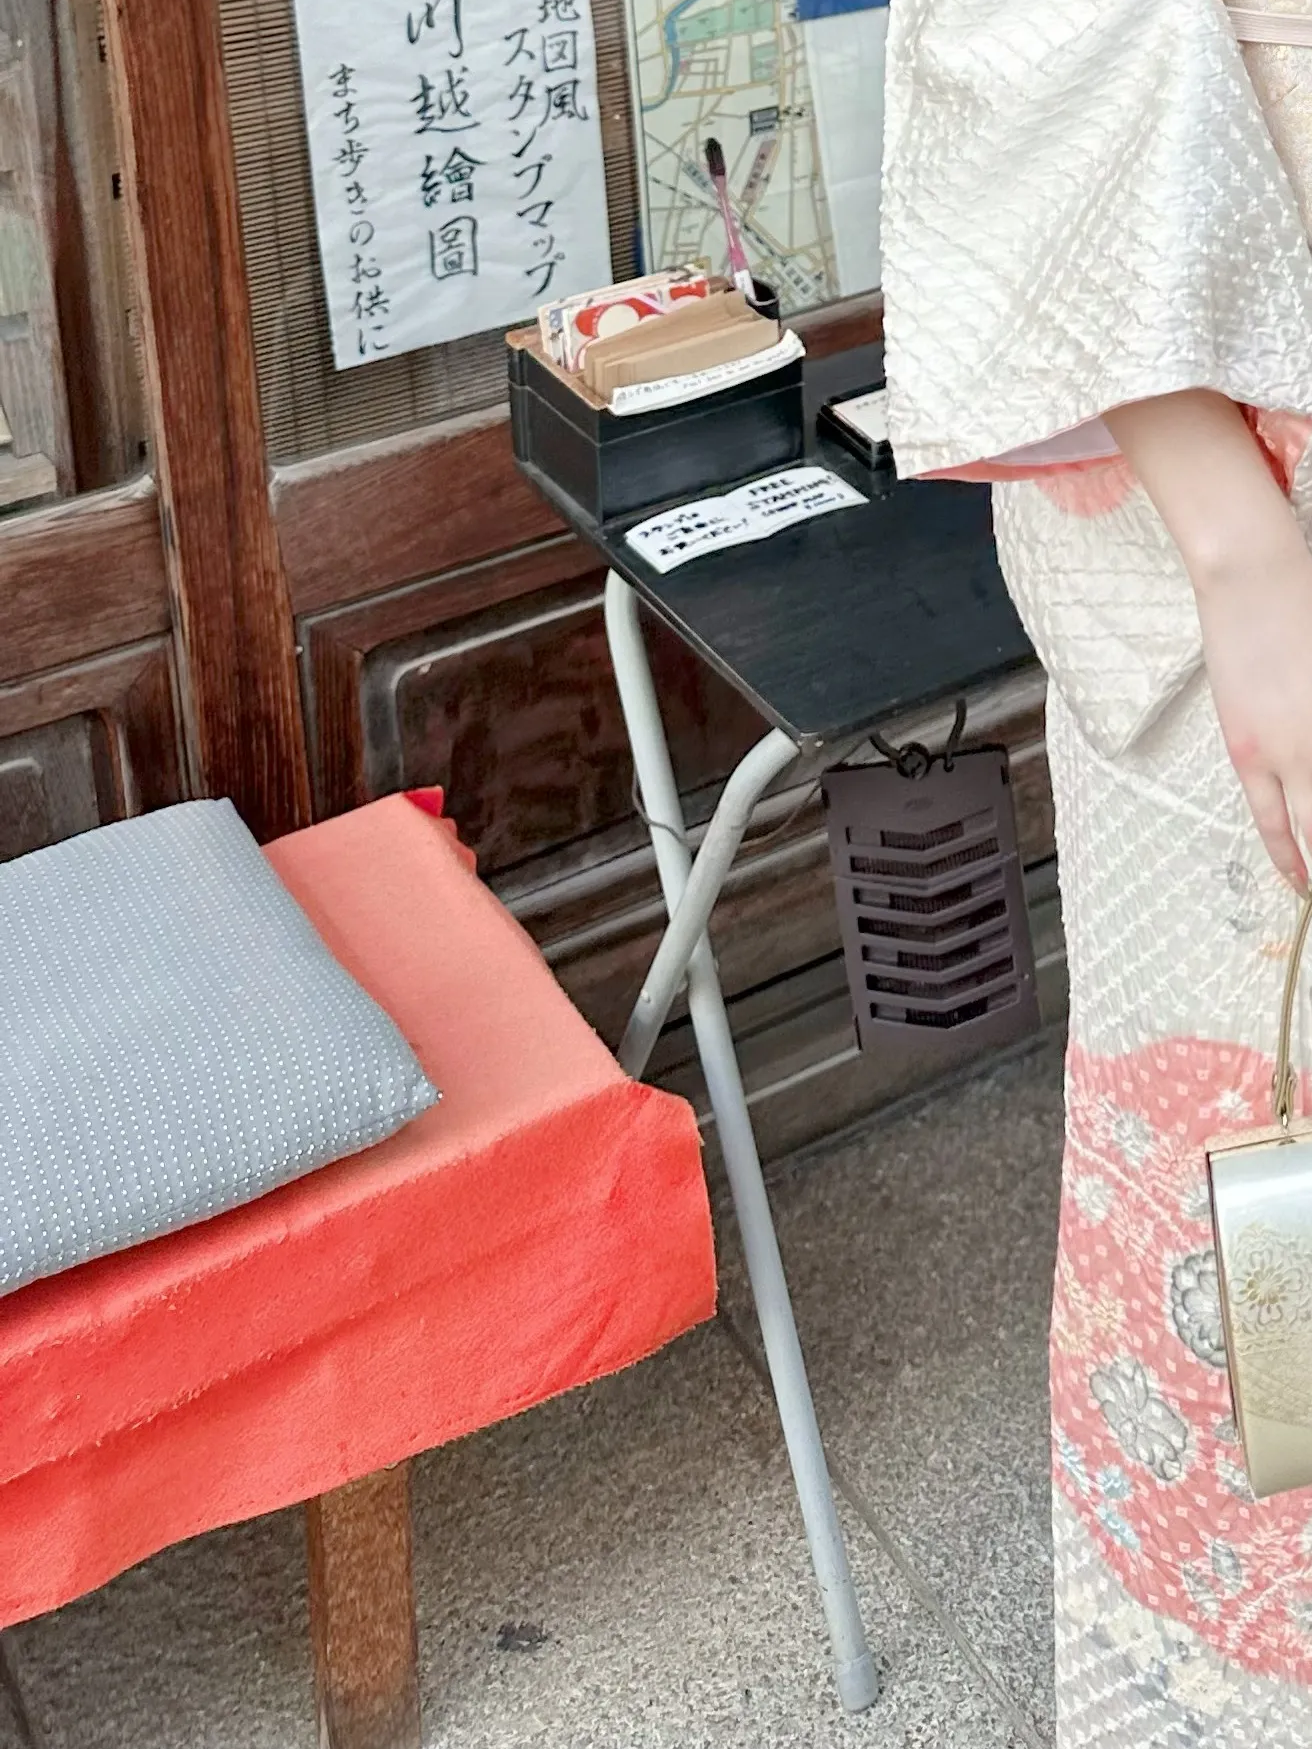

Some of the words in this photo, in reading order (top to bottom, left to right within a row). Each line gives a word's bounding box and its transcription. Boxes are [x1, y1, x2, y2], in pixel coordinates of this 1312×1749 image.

[328, 63, 390, 354] まち歩きのお供に
[504, 27, 566, 297] スタンプマップ
